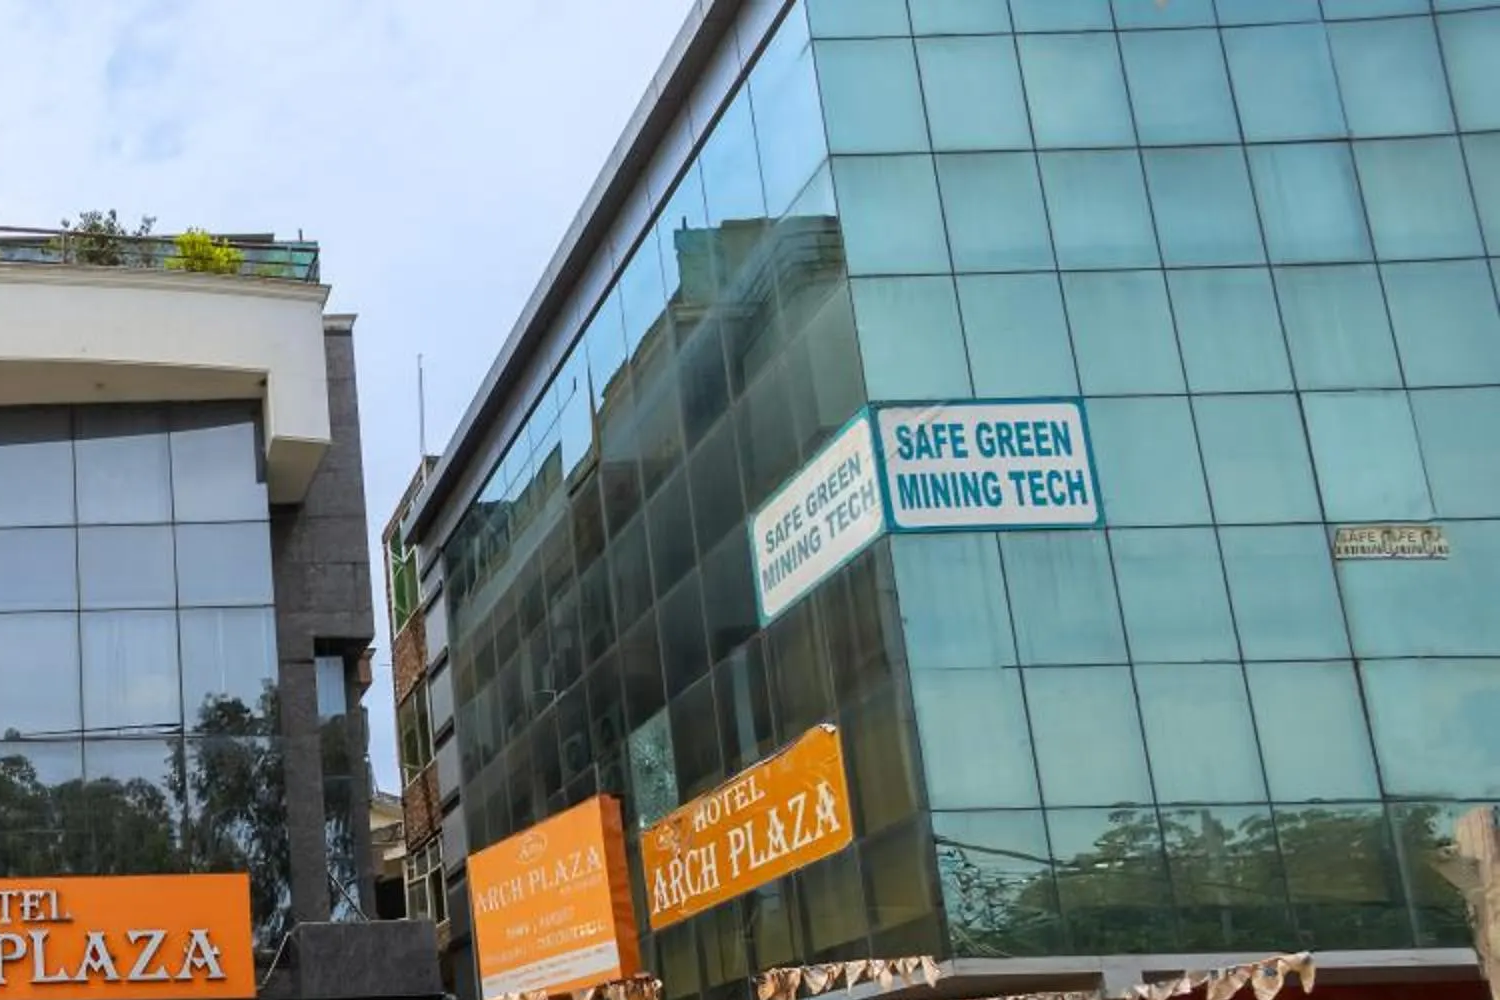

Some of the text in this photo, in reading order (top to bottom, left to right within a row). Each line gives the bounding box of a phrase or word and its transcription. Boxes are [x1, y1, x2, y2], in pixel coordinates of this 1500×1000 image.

[896, 420, 1073, 461] SAFE GREEN
[764, 452, 861, 554] SAFE GREEN
[897, 469, 1088, 510] MINING TECH
[762, 479, 876, 593] MINING TECH
[693, 775, 766, 833] HOTEL
[475, 874, 526, 913] ARCH
[528, 845, 603, 895] PLAZA
[652, 780, 841, 914] ARCH PLAZA
